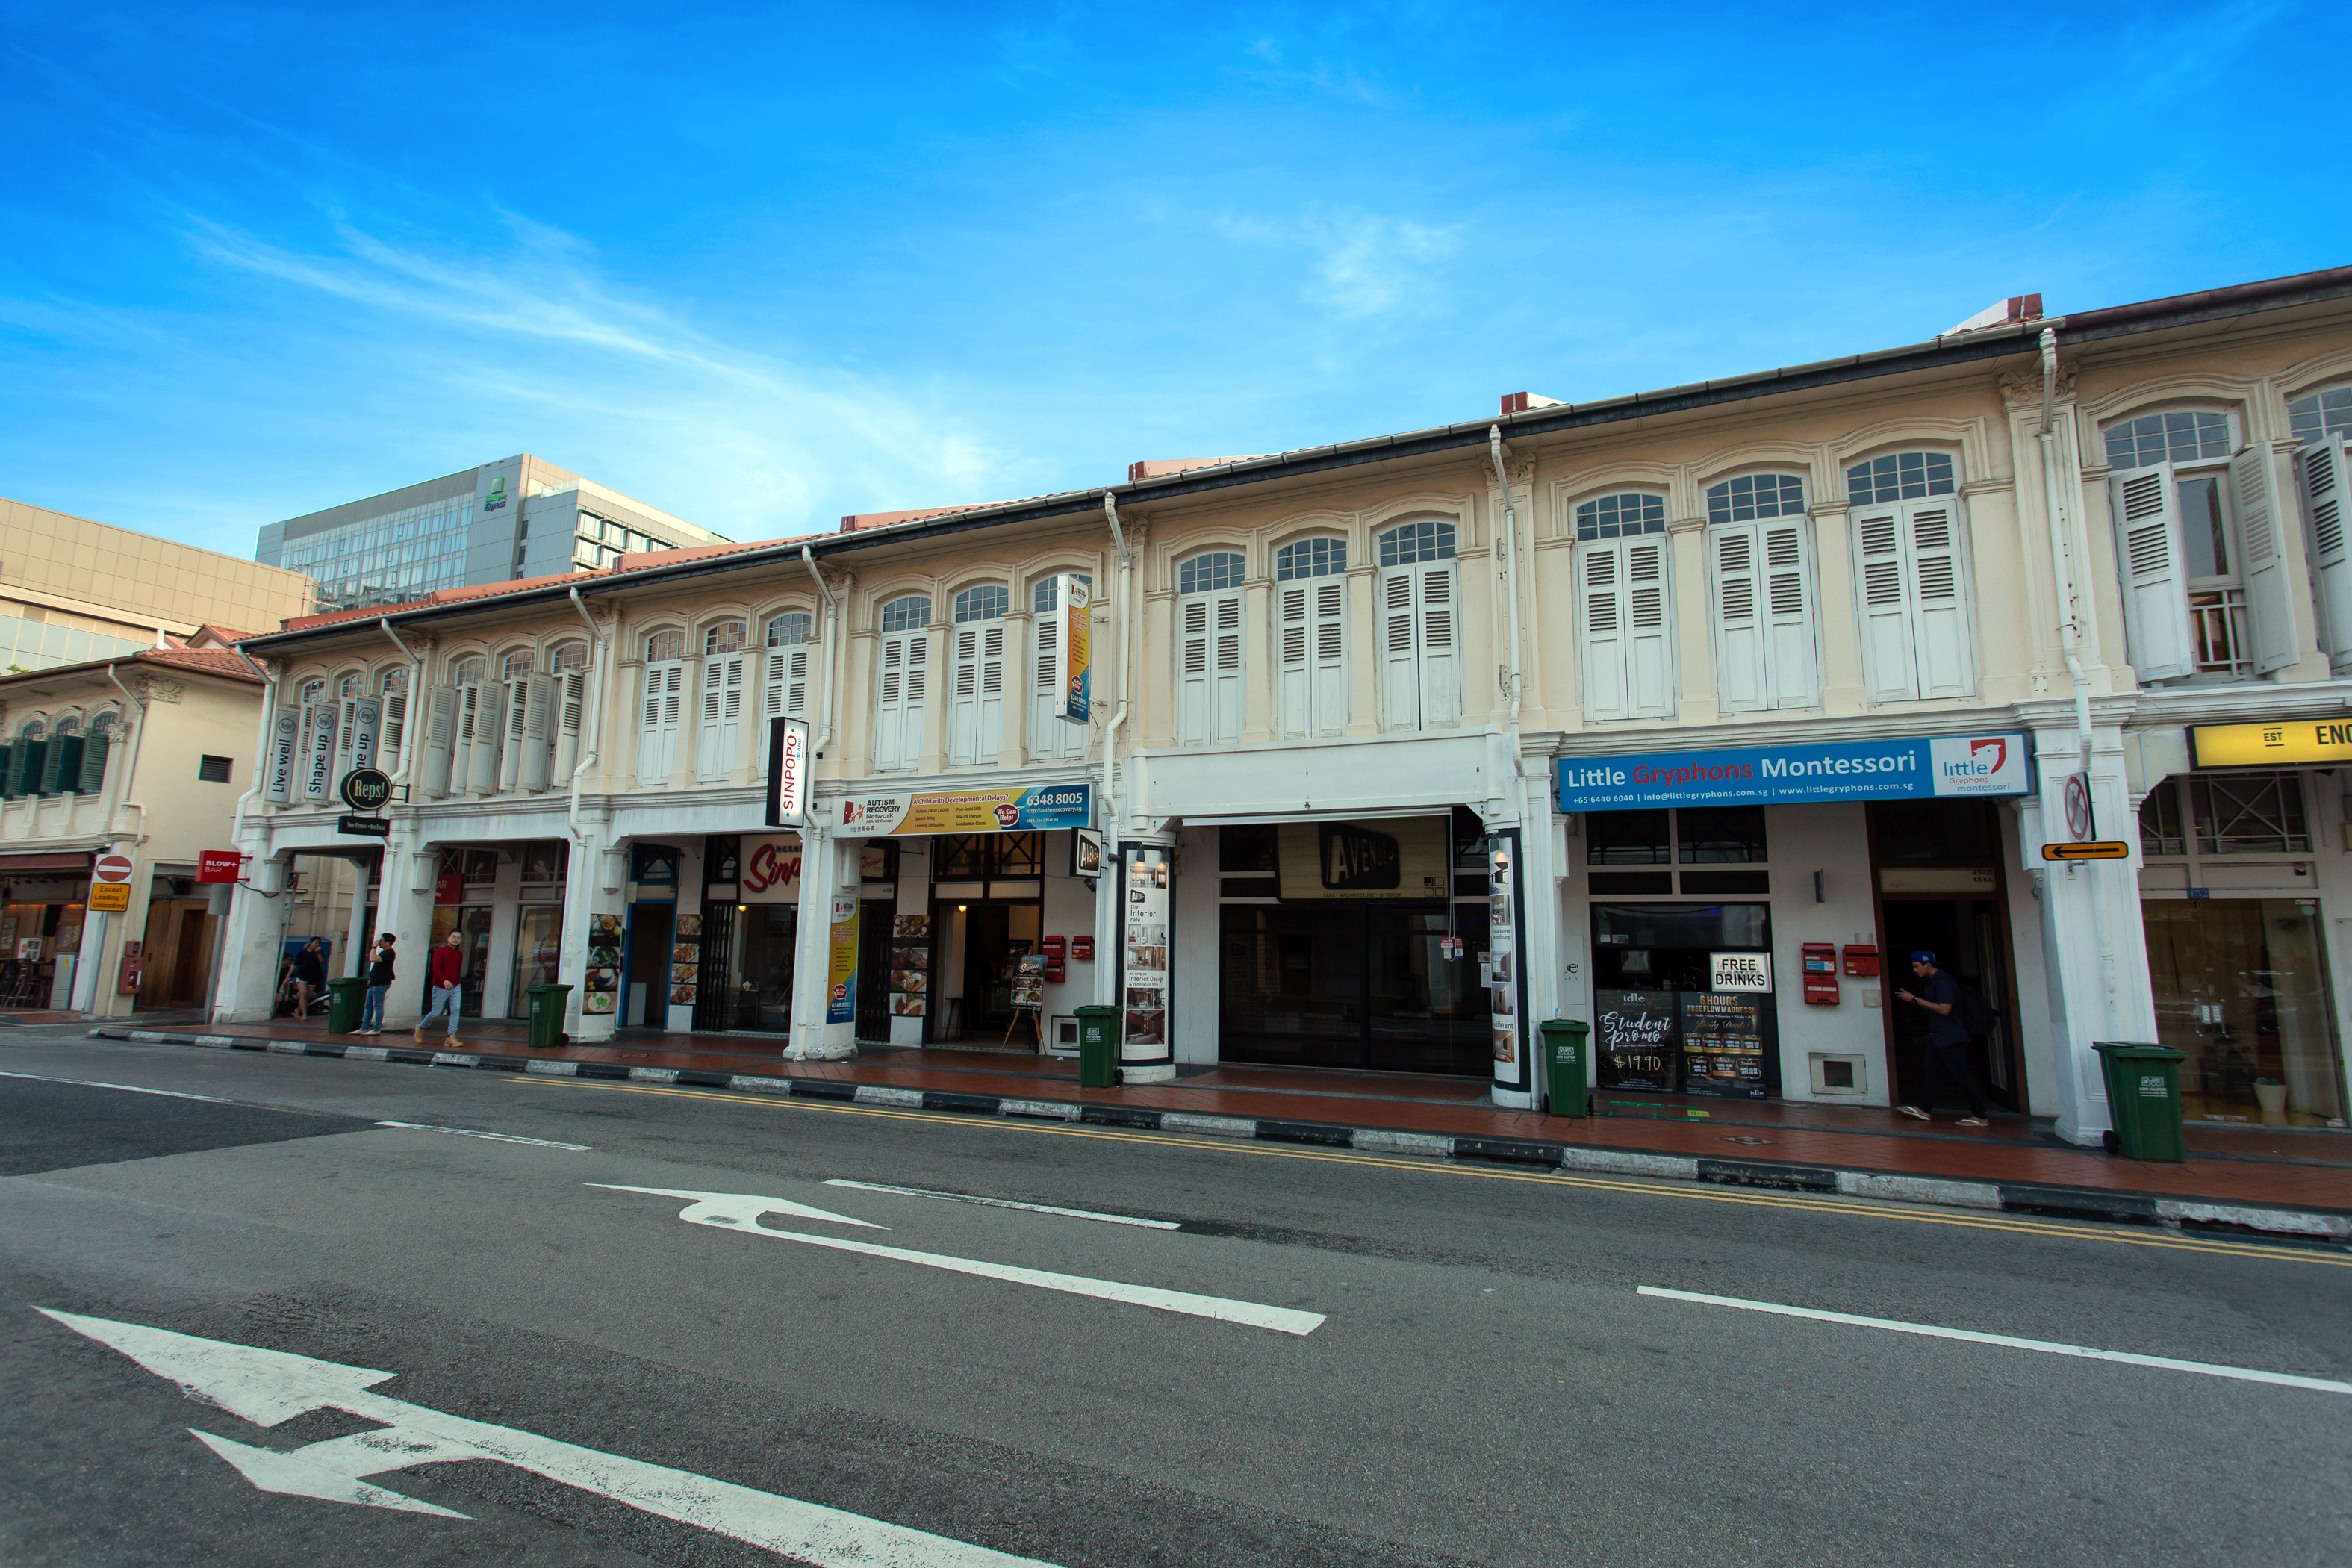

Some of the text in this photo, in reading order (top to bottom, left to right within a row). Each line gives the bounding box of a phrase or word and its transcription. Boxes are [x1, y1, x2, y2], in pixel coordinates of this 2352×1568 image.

[485, 500, 506, 511] Express
[2264, 732, 2283, 741] EST
[355, 733, 371, 769] ne up
[272, 738, 291, 793] Live well
[309, 734, 330, 794] Shape up
[1568, 750, 1916, 788] Little Gryphons Montessori
[1943, 761, 1988, 777] little
[783, 735, 797, 810] SINPOPO
[1949, 777, 1989, 785] Gryphons
[1957, 783, 2010, 792] montessori
[354, 780, 385, 800] Reps!
[1590, 795, 1611, 803] 6440
[1643, 788, 1768, 800] info@littlegryphons.com.sg
[1779, 782, 1914, 794] www.littlegryphons.com.sg
[945, 795, 986, 803] Developmental
[987, 794, 1008, 802] Delays?
[1027, 793, 1083, 806] 6348 8005
[1327, 834, 1388, 884] AVENUE
[743, 844, 802, 893] Sinp
[437, 880, 447, 889] AR
[94, 894, 119, 902] Loading
[1722, 959, 1756, 971] FREE
[1715, 974, 1765, 986] DRINKS
[1623, 993, 1645, 1002] idle
[1700, 995, 1738, 1006] 6 HOURS
[1599, 1011, 1672, 1033] Student
[1696, 1019, 1720, 1030] Daily
[1614, 1054, 1661, 1071] $19.90
